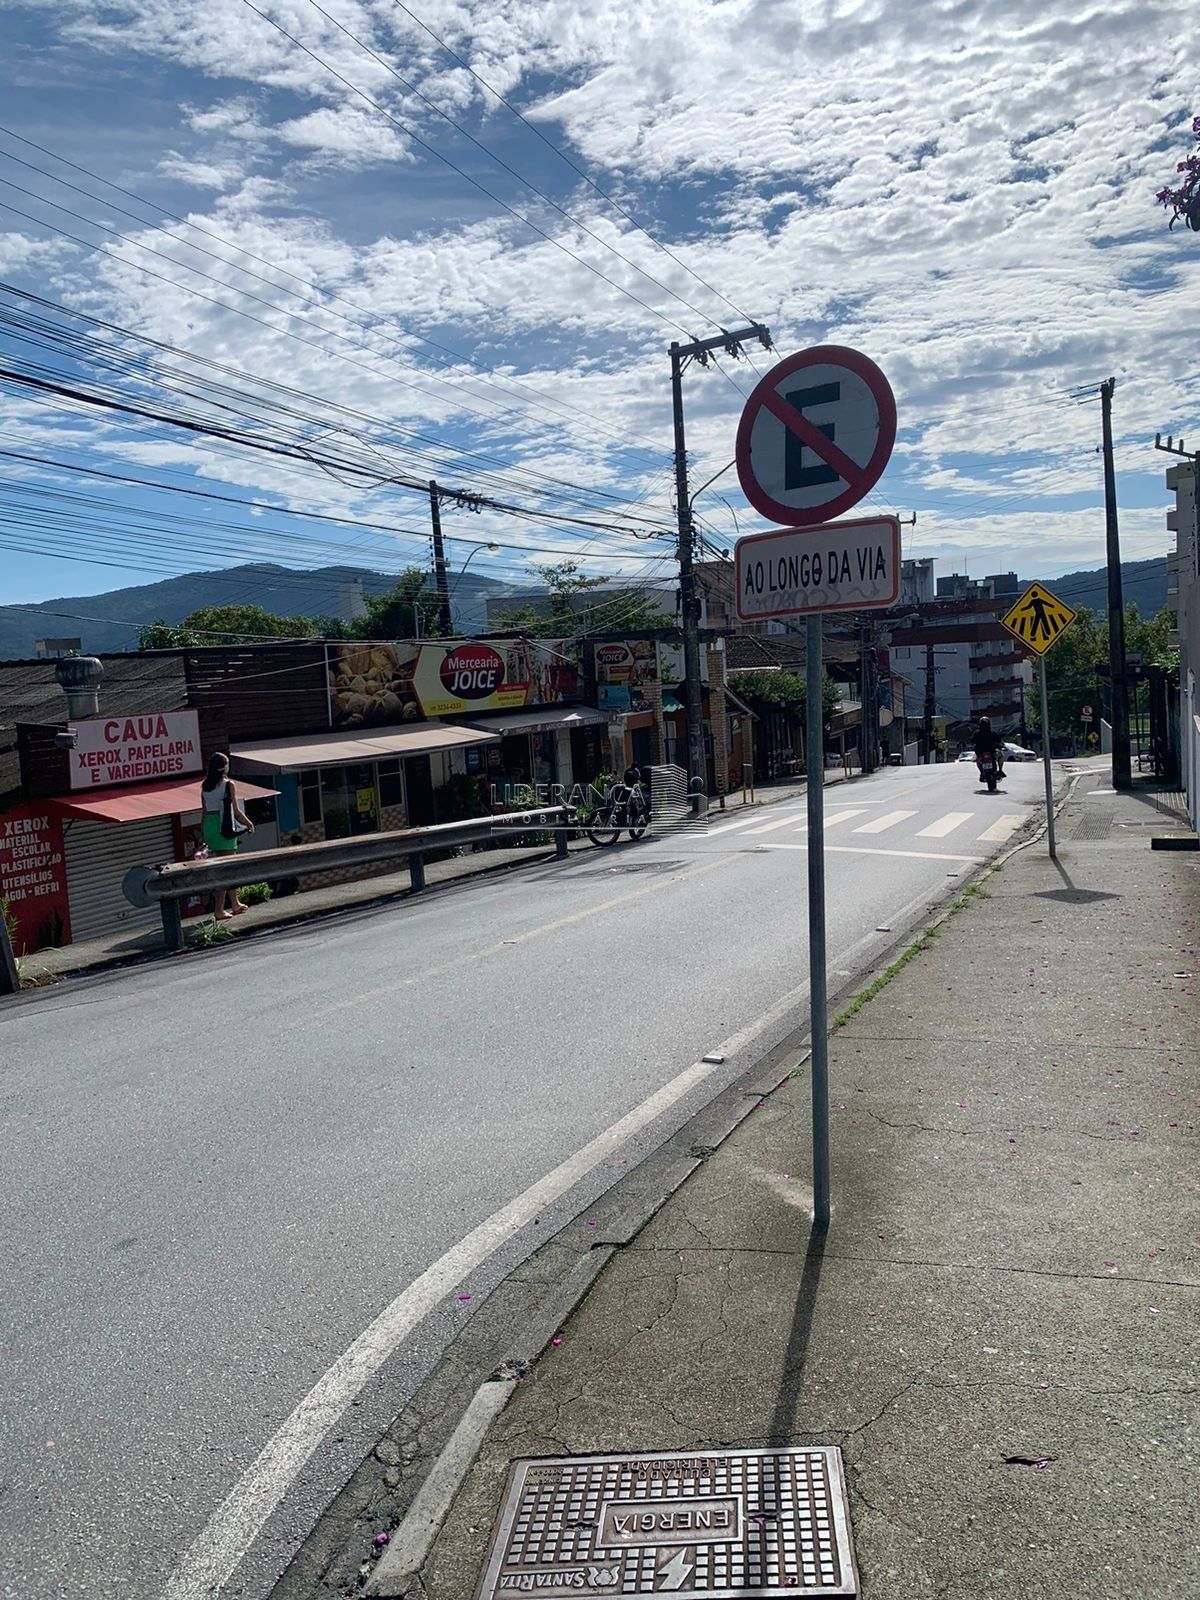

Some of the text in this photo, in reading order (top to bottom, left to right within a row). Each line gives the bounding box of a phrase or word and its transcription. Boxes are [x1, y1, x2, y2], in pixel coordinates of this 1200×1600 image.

[785, 381, 840, 491] E
[745, 546, 886, 595] AO LONGO DA VIA
[448, 656, 499, 670] Mercearia
[451, 669, 496, 691] JOICE
[128, 740, 194, 761] PAPELARIA
[91, 757, 184, 783] E VARIEDADES
[4, 816, 50, 836] XEROX
[12, 842, 51, 858] ESCOLAR
[34, 881, 60, 897] REFRI
[637, 1467, 711, 1480] CUIDADO
[614, 1509, 729, 1534] ENERGIA
